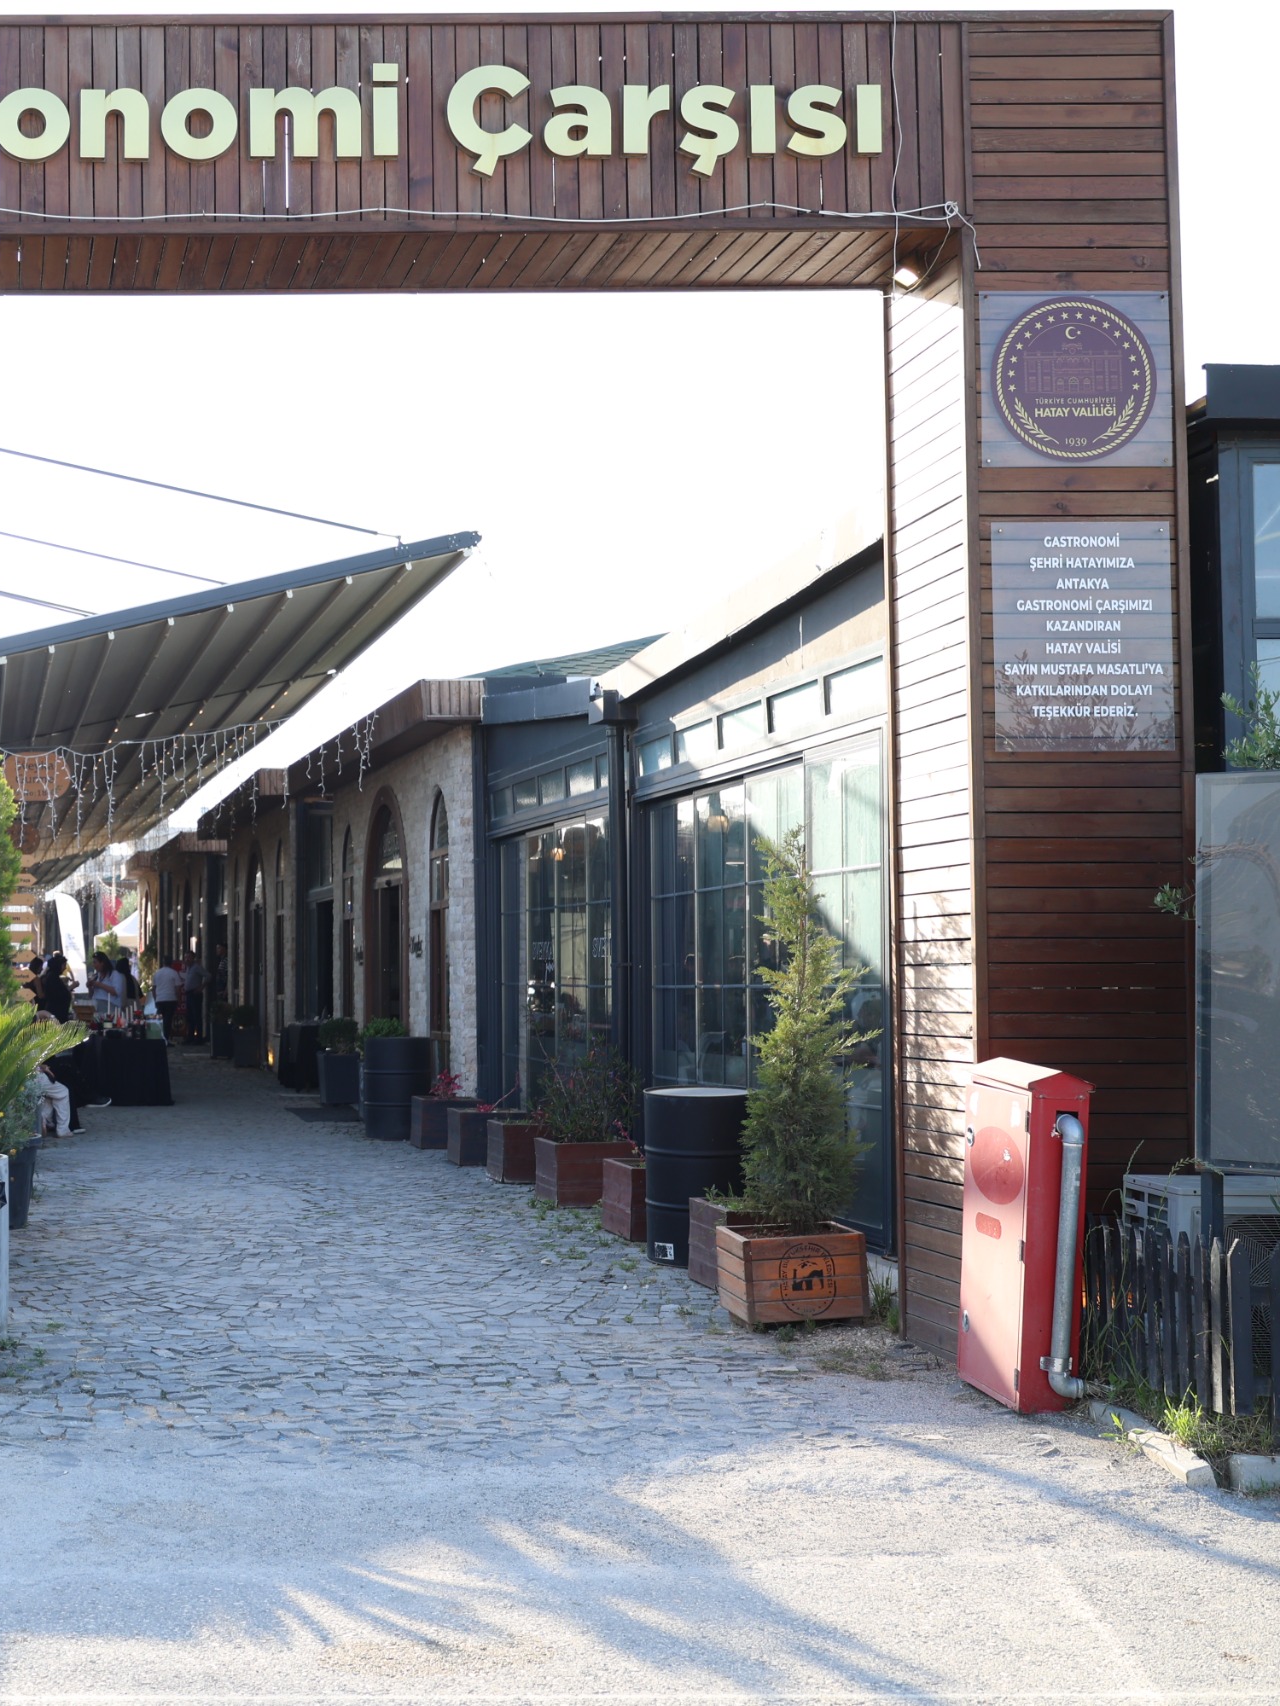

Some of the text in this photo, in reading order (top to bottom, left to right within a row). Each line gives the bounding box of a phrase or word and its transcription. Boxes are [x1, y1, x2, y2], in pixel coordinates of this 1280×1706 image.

[446, 64, 883, 179] Çarşısı
[1034, 404, 1116, 417] HATAY VALİLİĞİ
[1065, 437, 1087, 447] 1939
[1043, 532, 1120, 548] GASTRONOMİ
[1029, 553, 1135, 571] ŞEHRİ HATAYIMIZA
[1056, 578, 1109, 589] ANTAKYA
[1016, 596, 1153, 614] GASTRONOMİ ÇARŞIMIZI
[1046, 620, 1121, 632] KAZANDIRAN
[1045, 639, 1121, 654] HATAY VALİSİ
[1004, 662, 1164, 675] SAYIN MUSTAFA MASATLI'YA
[1016, 684, 1153, 696] KATKILARINDAN DOLAYI
[1032, 702, 1139, 720] TEŞEKKÜR EDERİZ.
